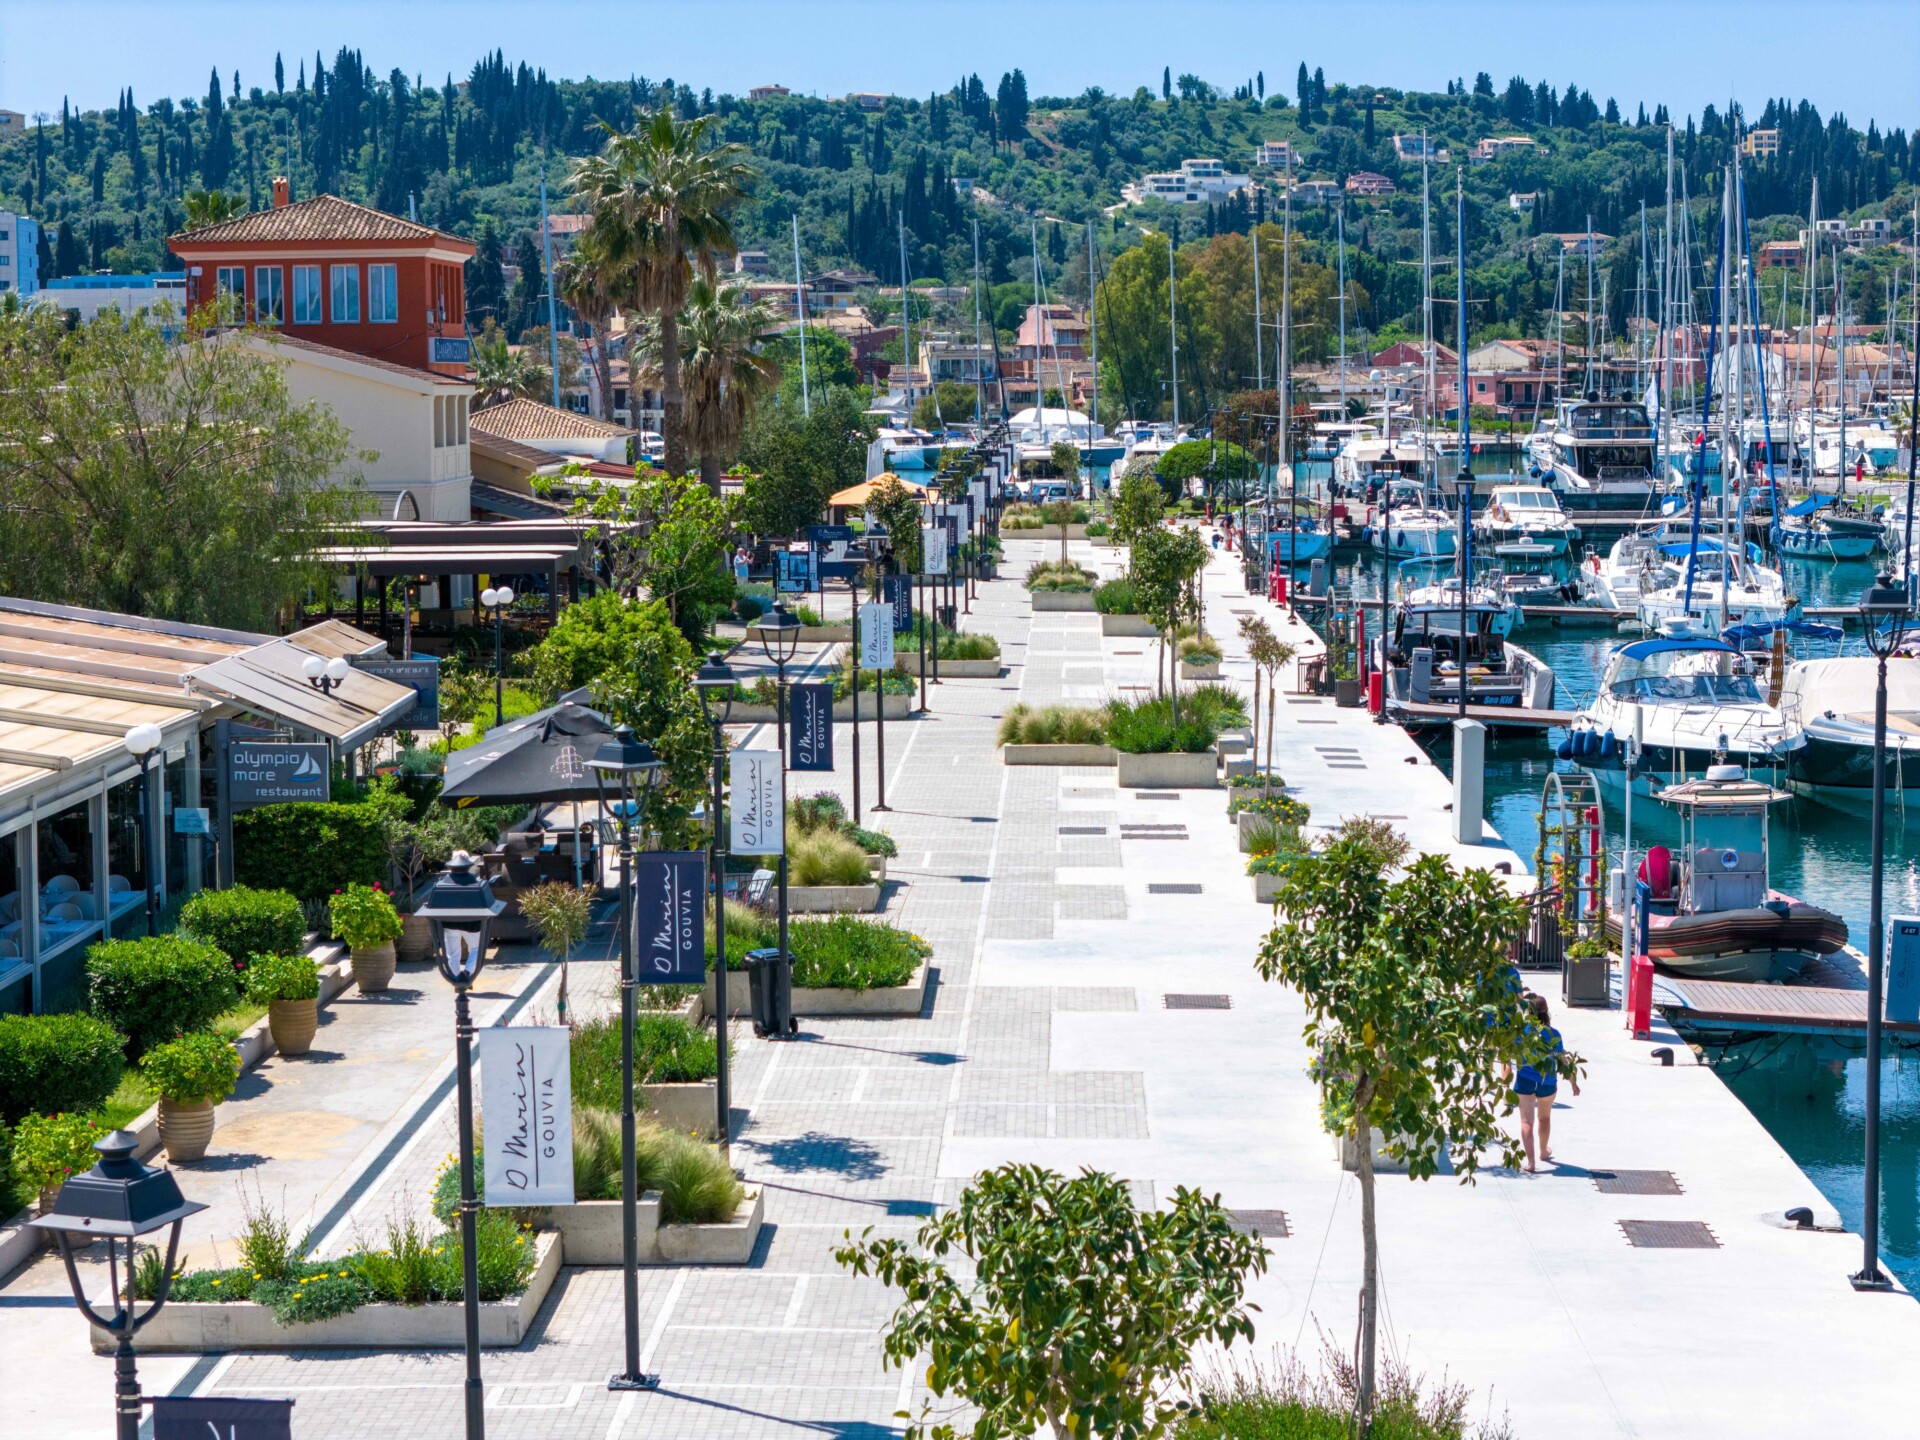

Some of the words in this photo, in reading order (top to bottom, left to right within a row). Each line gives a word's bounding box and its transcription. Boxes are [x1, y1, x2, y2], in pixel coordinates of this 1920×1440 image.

[867, 608, 878, 652] Marin
[798, 690, 812, 749] Marin
[1483, 695, 1499, 704] Sea
[1500, 695, 1514, 704] Kid
[255, 786, 322, 797] restaurant
[741, 758, 757, 828] Marin
[765, 779, 773, 828] GOUVIA
[651, 863, 672, 950] Marin
[682, 889, 692, 950] GOUVIA
[502, 1043, 528, 1159] Marin
[542, 1078, 556, 1159] GOUVIA
